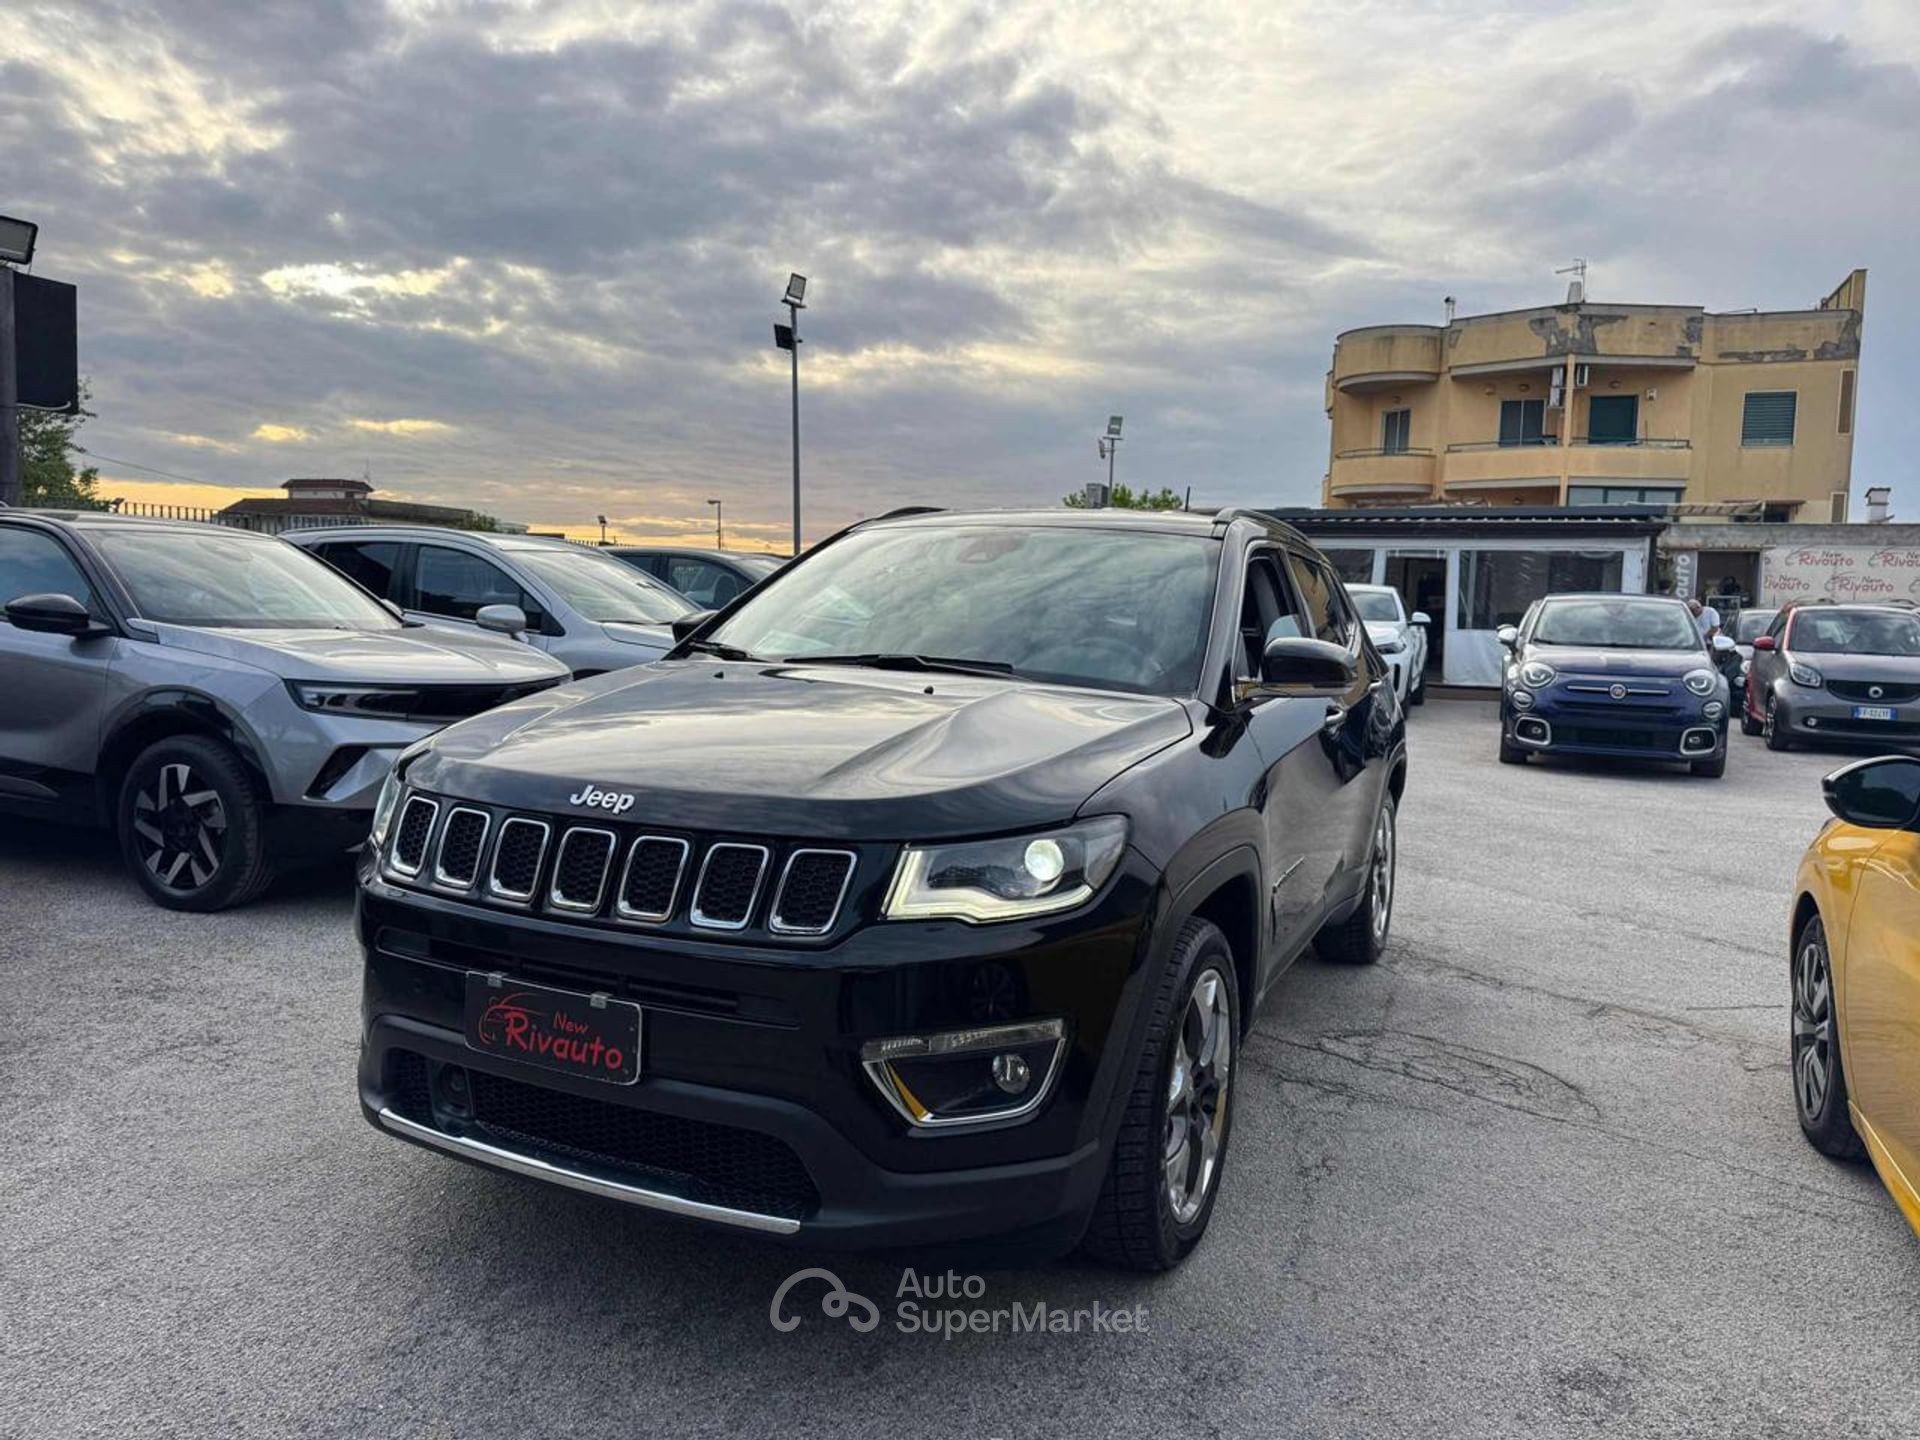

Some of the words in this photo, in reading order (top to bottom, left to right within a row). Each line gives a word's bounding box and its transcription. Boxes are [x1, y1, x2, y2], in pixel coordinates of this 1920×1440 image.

[1799, 551, 1854, 566] Rivauto
[1765, 575, 1810, 590] ivauto
[1838, 576, 1894, 592] Rivauto
[570, 785, 635, 814] Jeep
[553, 1011, 588, 1034] New
[504, 1012, 623, 1069] Rivauto
